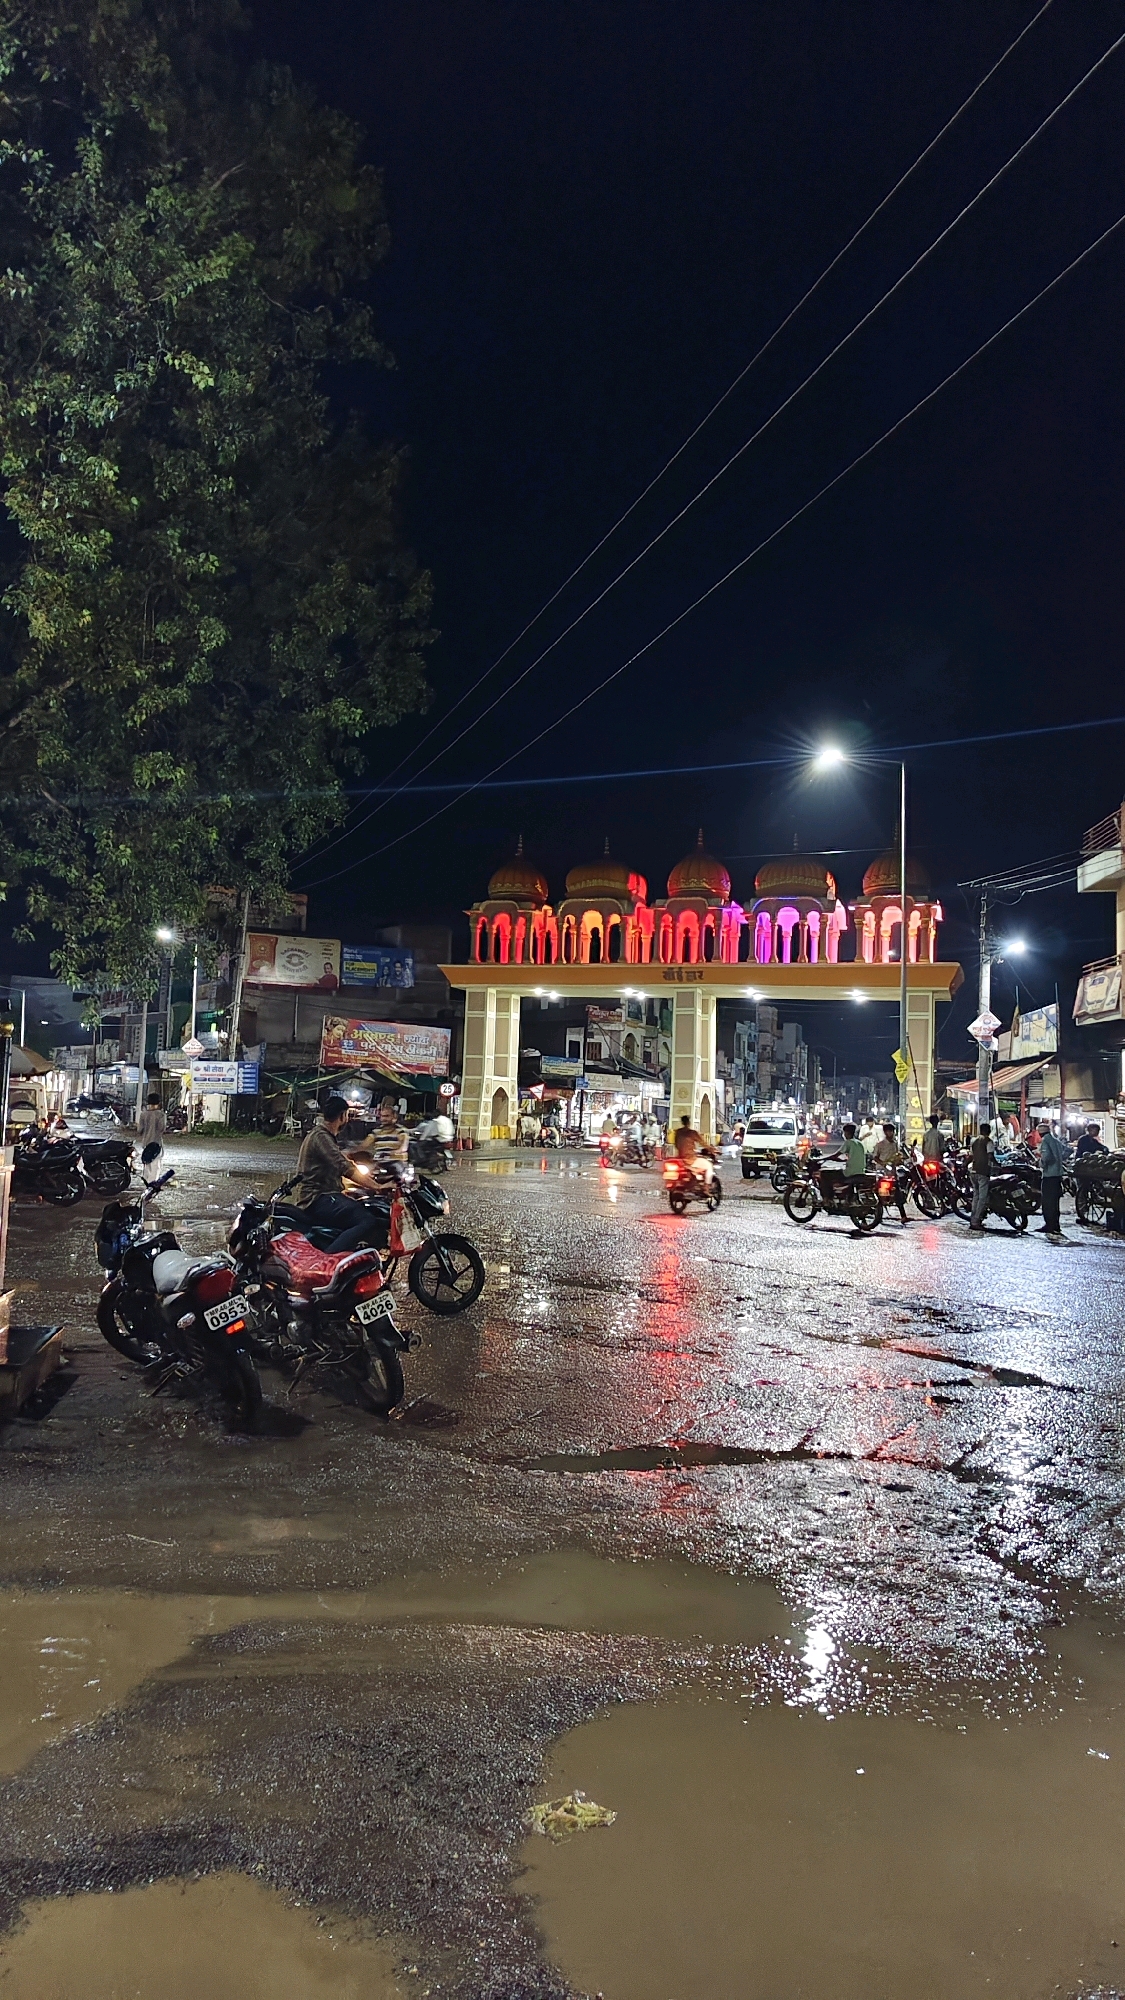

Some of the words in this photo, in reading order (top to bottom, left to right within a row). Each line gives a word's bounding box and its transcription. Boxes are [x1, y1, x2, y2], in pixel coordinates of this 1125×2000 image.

[443, 1084, 453, 1094] 25
[210, 1303, 247, 1328] 0953
[363, 1299, 394, 1321] 4026
